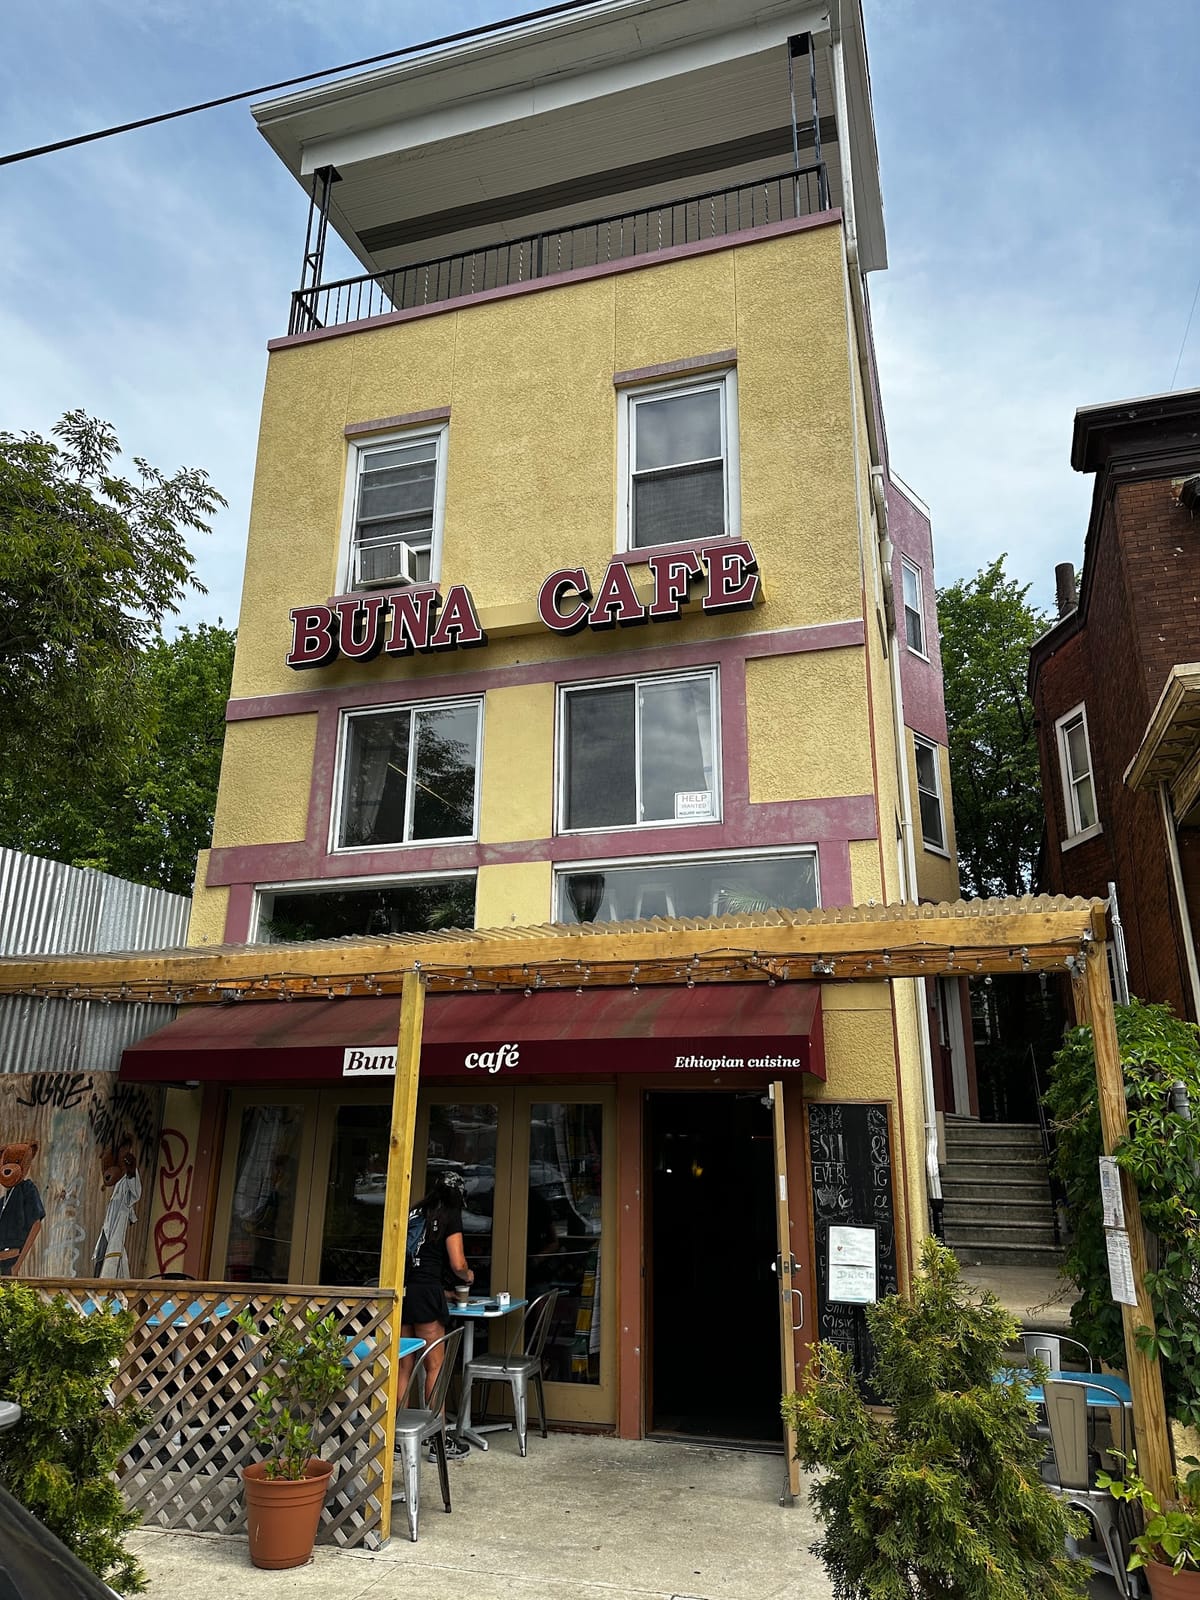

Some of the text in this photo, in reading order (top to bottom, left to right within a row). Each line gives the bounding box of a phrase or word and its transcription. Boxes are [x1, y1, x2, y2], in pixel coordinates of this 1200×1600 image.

[286, 541, 758, 669] BUNA CAFE
[681, 794, 707, 803] HELP
[345, 1043, 520, 1074] Bun café
[674, 1055, 801, 1071] Ethiopian cuisine
